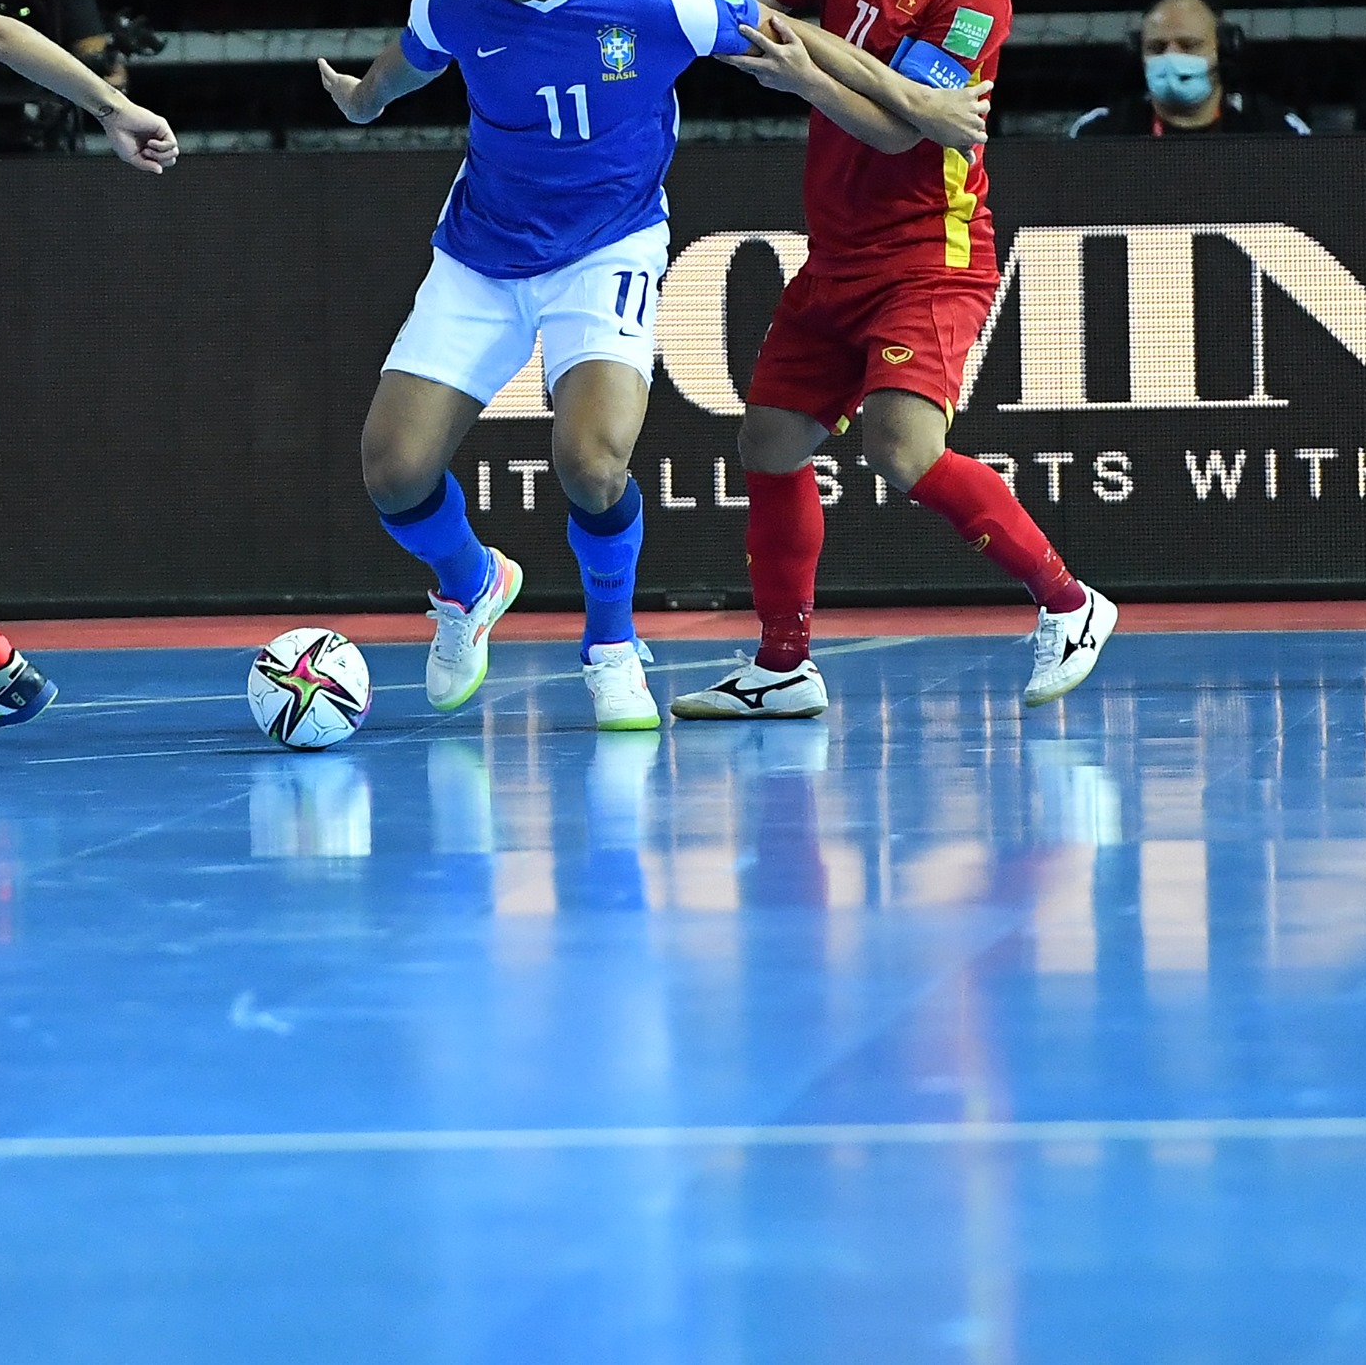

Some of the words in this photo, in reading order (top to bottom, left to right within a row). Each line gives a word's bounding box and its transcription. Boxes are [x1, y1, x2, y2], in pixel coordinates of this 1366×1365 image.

[601, 69, 638, 82] BRASIL
[535, 84, 590, 140] 11
[612, 270, 649, 328] 11
[478, 459, 550, 512] IT
[626, 457, 749, 510] LL
